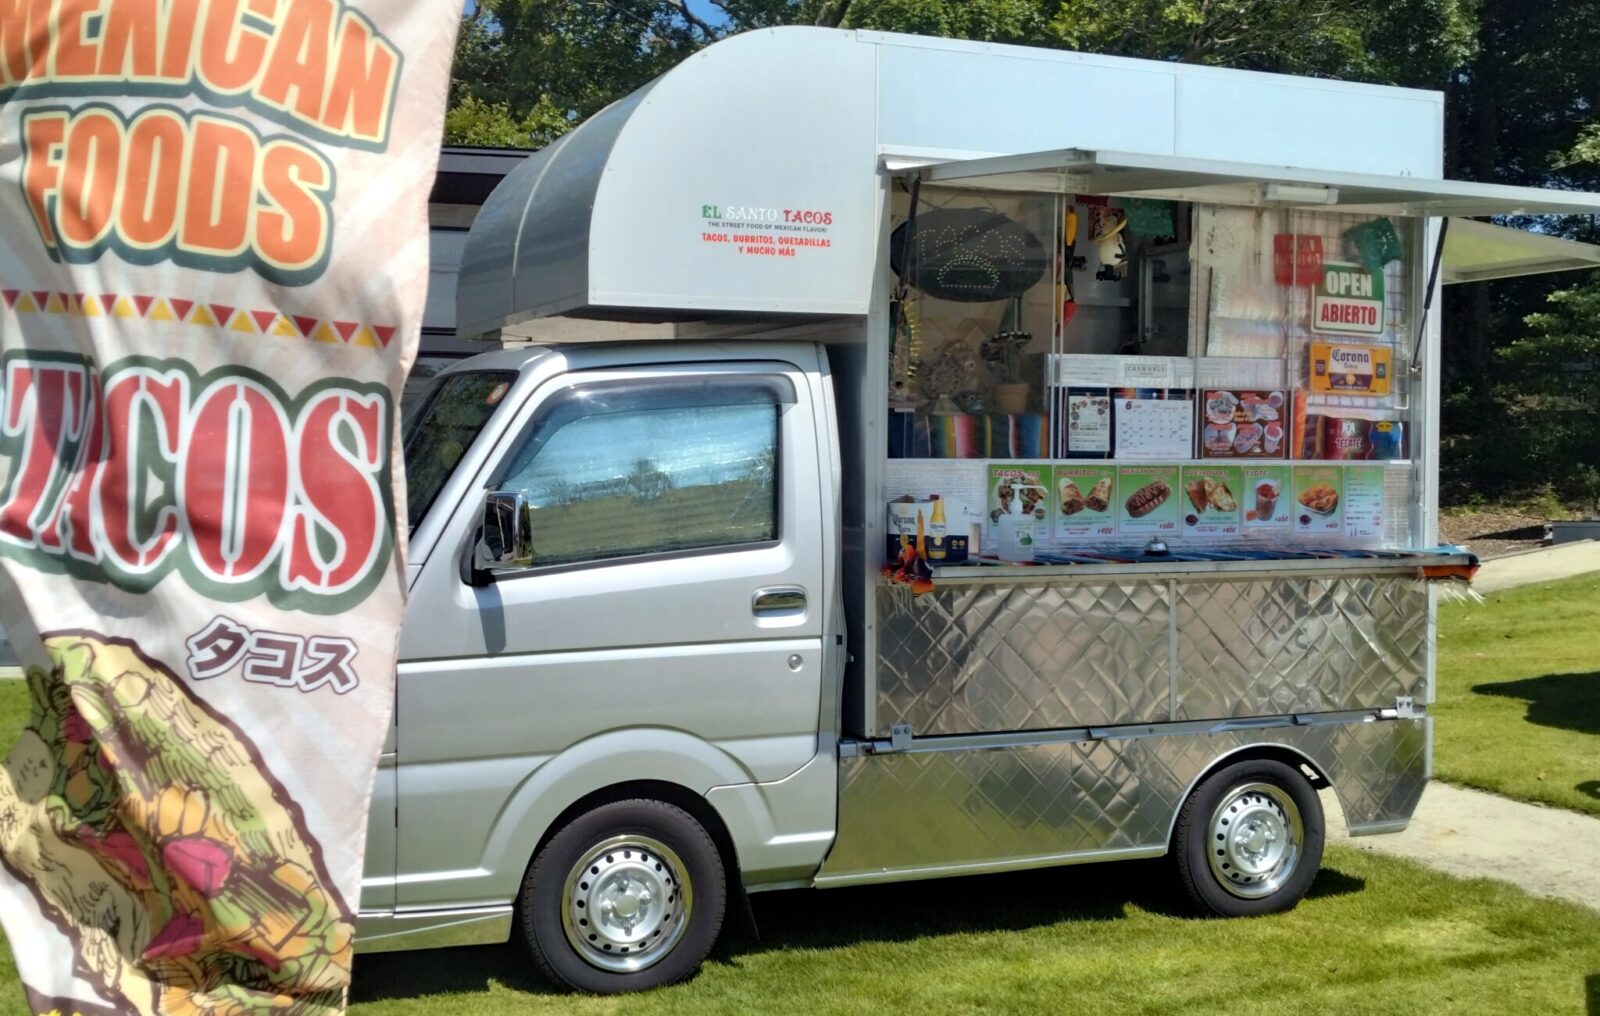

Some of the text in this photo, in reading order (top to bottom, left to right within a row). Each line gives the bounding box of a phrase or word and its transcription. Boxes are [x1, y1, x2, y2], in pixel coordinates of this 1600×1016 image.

[21, 105, 334, 280] FOODS
[702, 205, 833, 225] EL SANTO TACOS
[733, 235, 776, 245] BURRITOS,
[778, 236, 831, 247] QUESADILLAS
[912, 224, 1026, 266] TACOS
[738, 245, 796, 257] Y MUCHO MÁS
[1326, 270, 1373, 297] OPEN
[1321, 303, 1377, 326] ABIERTO
[1332, 349, 1369, 363] Corona
[1125, 401, 1133, 410] 6
[1335, 437, 1362, 449] TECATE
[0, 350, 394, 612] TACOS
[992, 469, 1024, 478] TACOS
[893, 515, 915, 525] Corona
[187, 615, 359, 694] タコス
